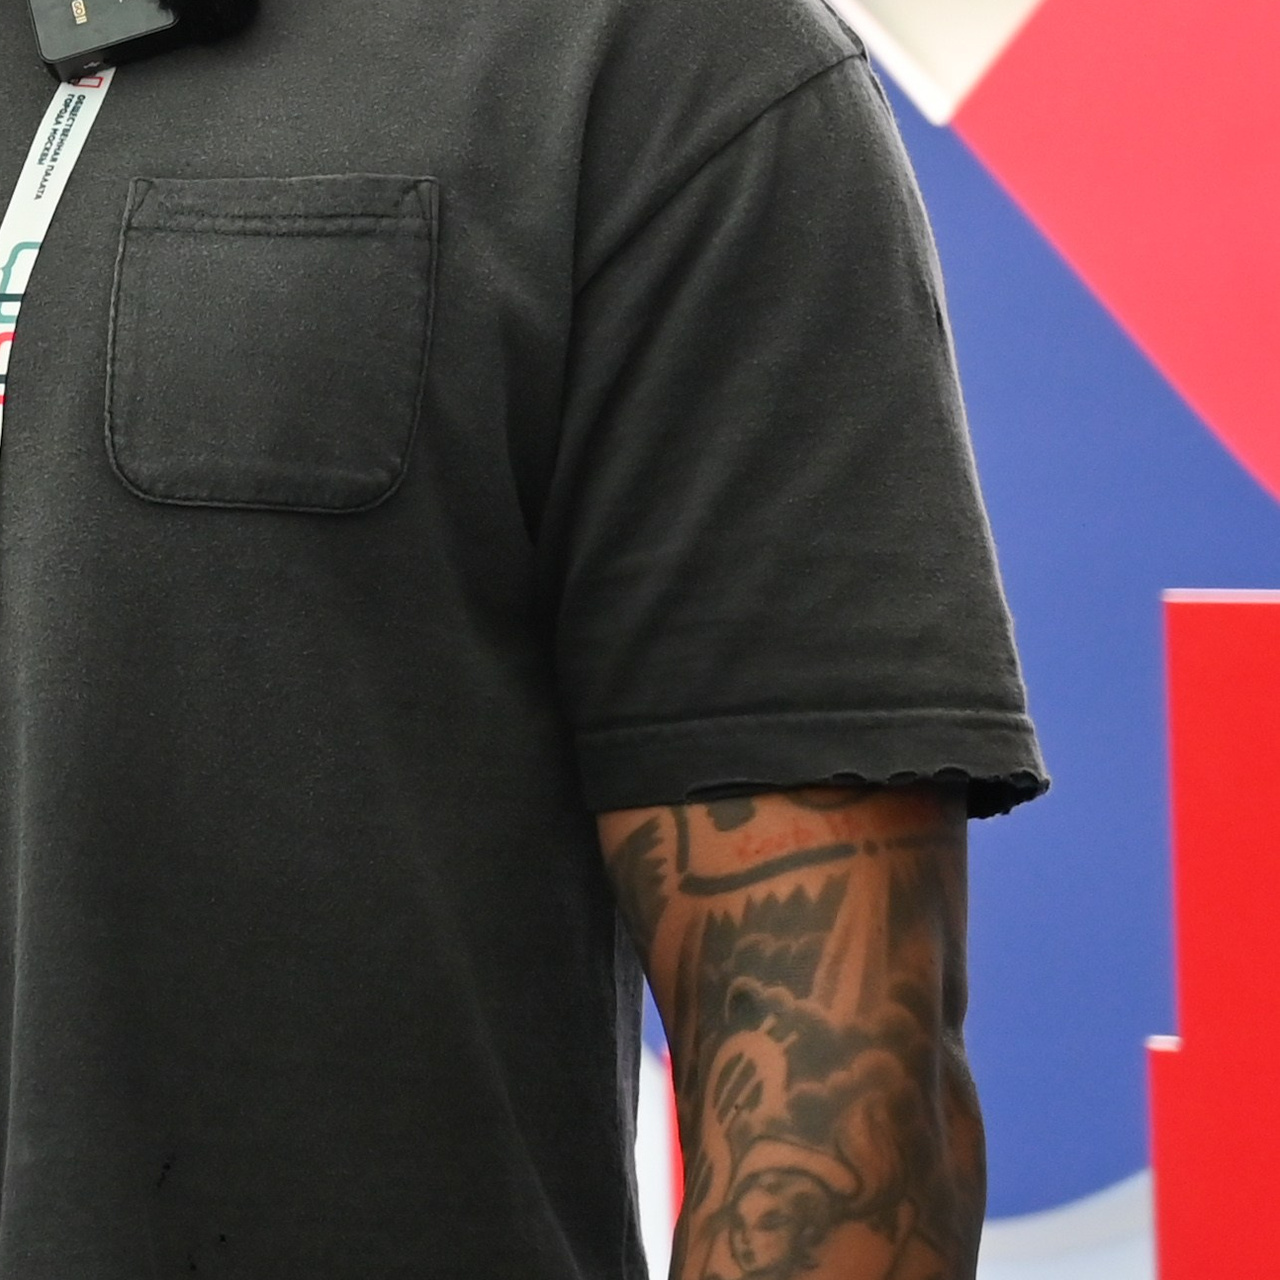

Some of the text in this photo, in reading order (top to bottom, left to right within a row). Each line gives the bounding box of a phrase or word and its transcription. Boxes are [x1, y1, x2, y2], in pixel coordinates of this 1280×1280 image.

[34, 94, 86, 201] ОБЩЕСТВЕННАЯ ПАЛАТА
[37, 93, 75, 165] ГОРОДА МОСКВЫ
